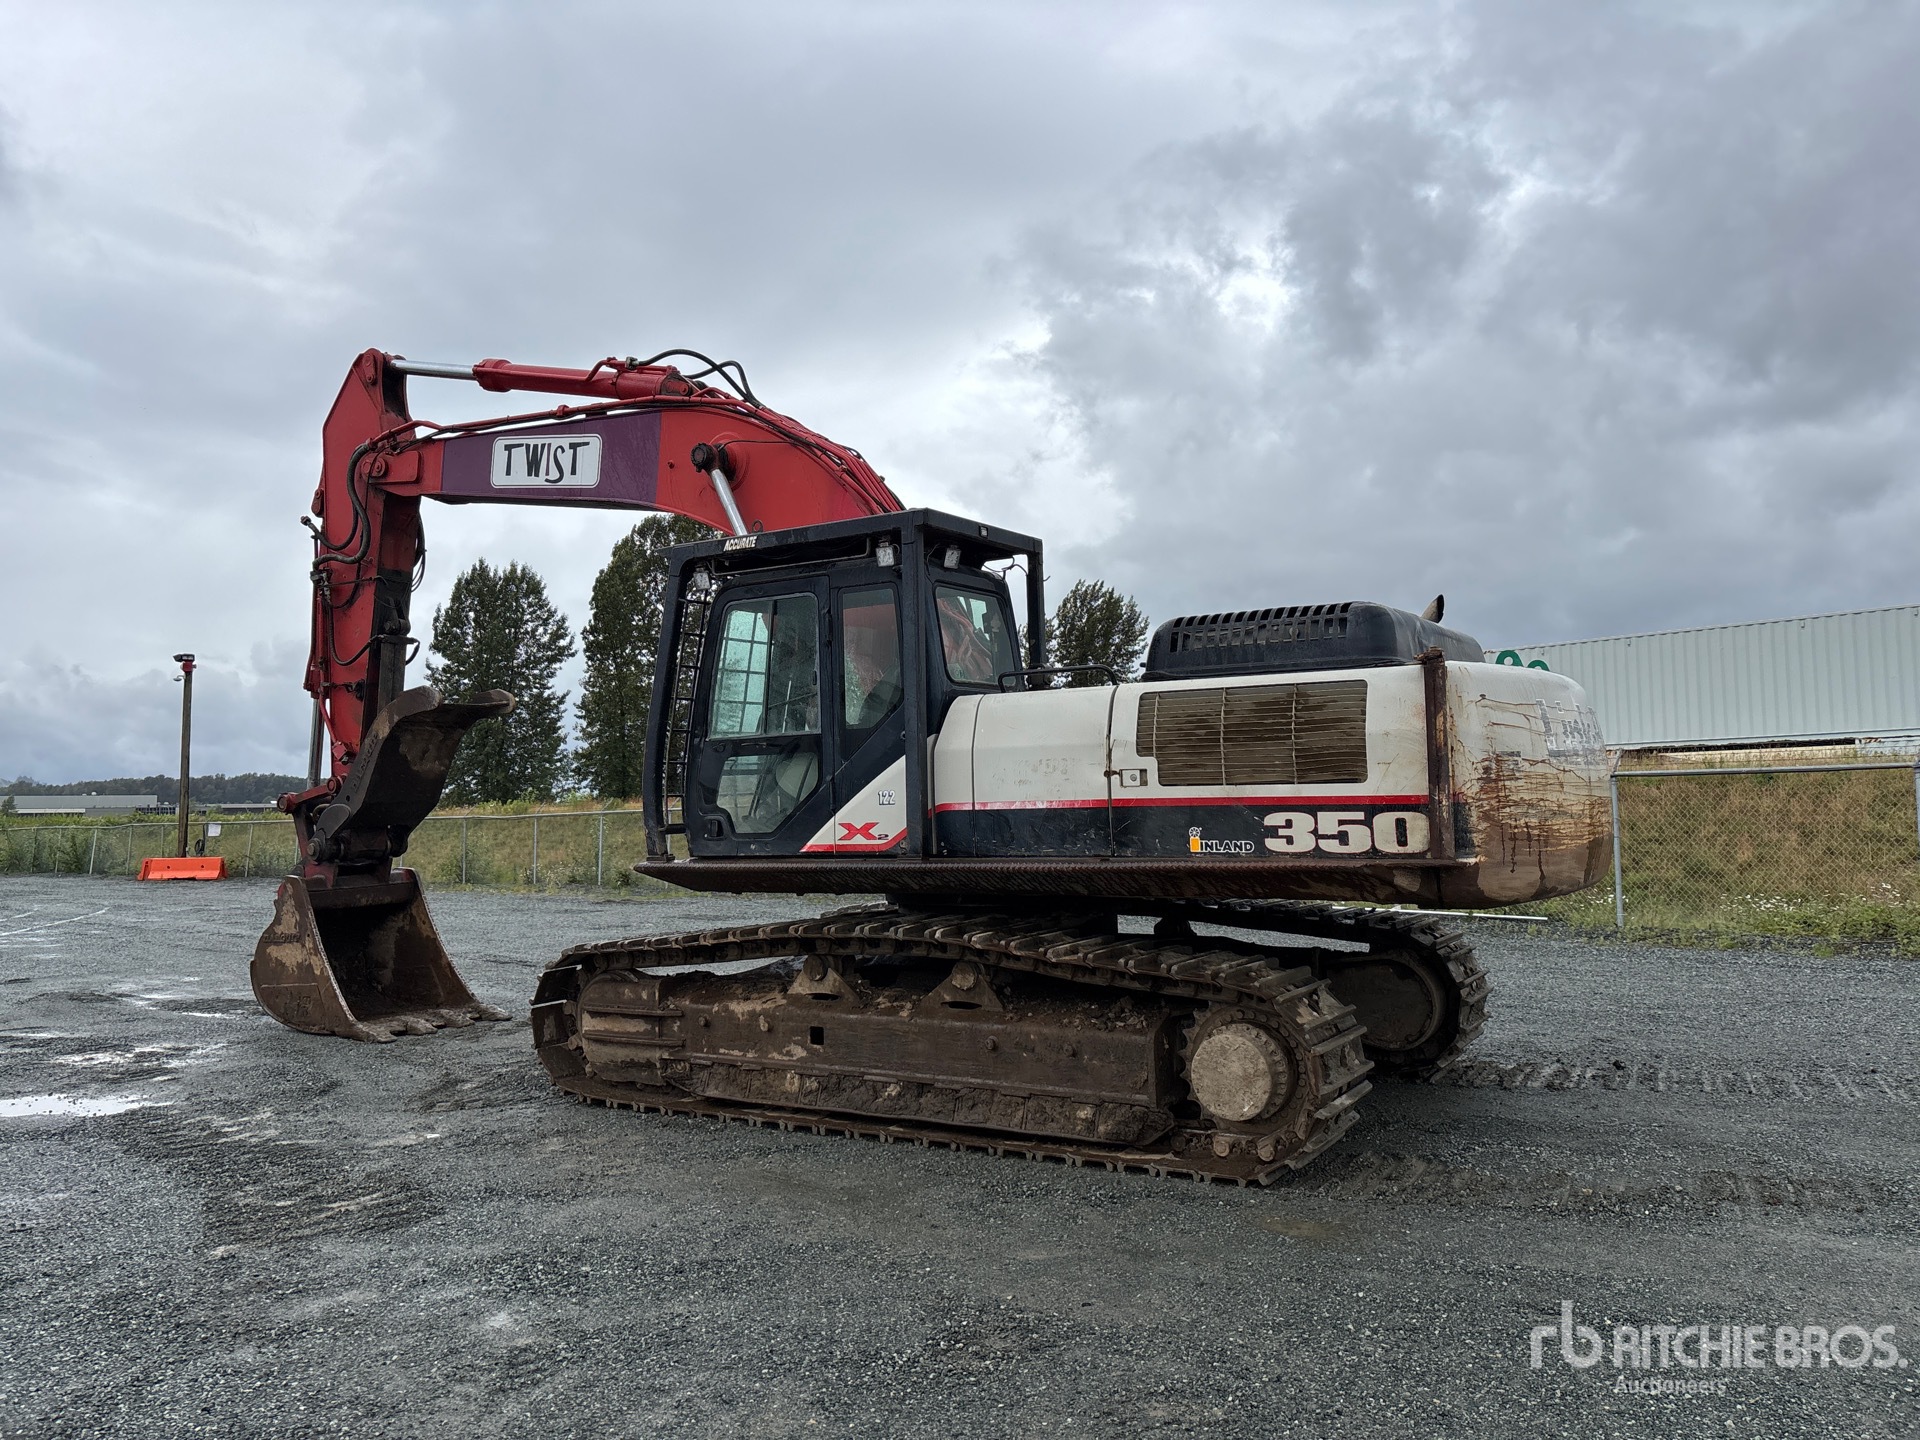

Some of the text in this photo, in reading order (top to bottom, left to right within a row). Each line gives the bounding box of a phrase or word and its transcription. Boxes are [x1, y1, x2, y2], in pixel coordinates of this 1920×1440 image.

[504, 442, 590, 484] TWIST
[723, 535, 758, 552] ACCURATE
[878, 790, 896, 806] 122
[1263, 811, 1430, 854] 350
